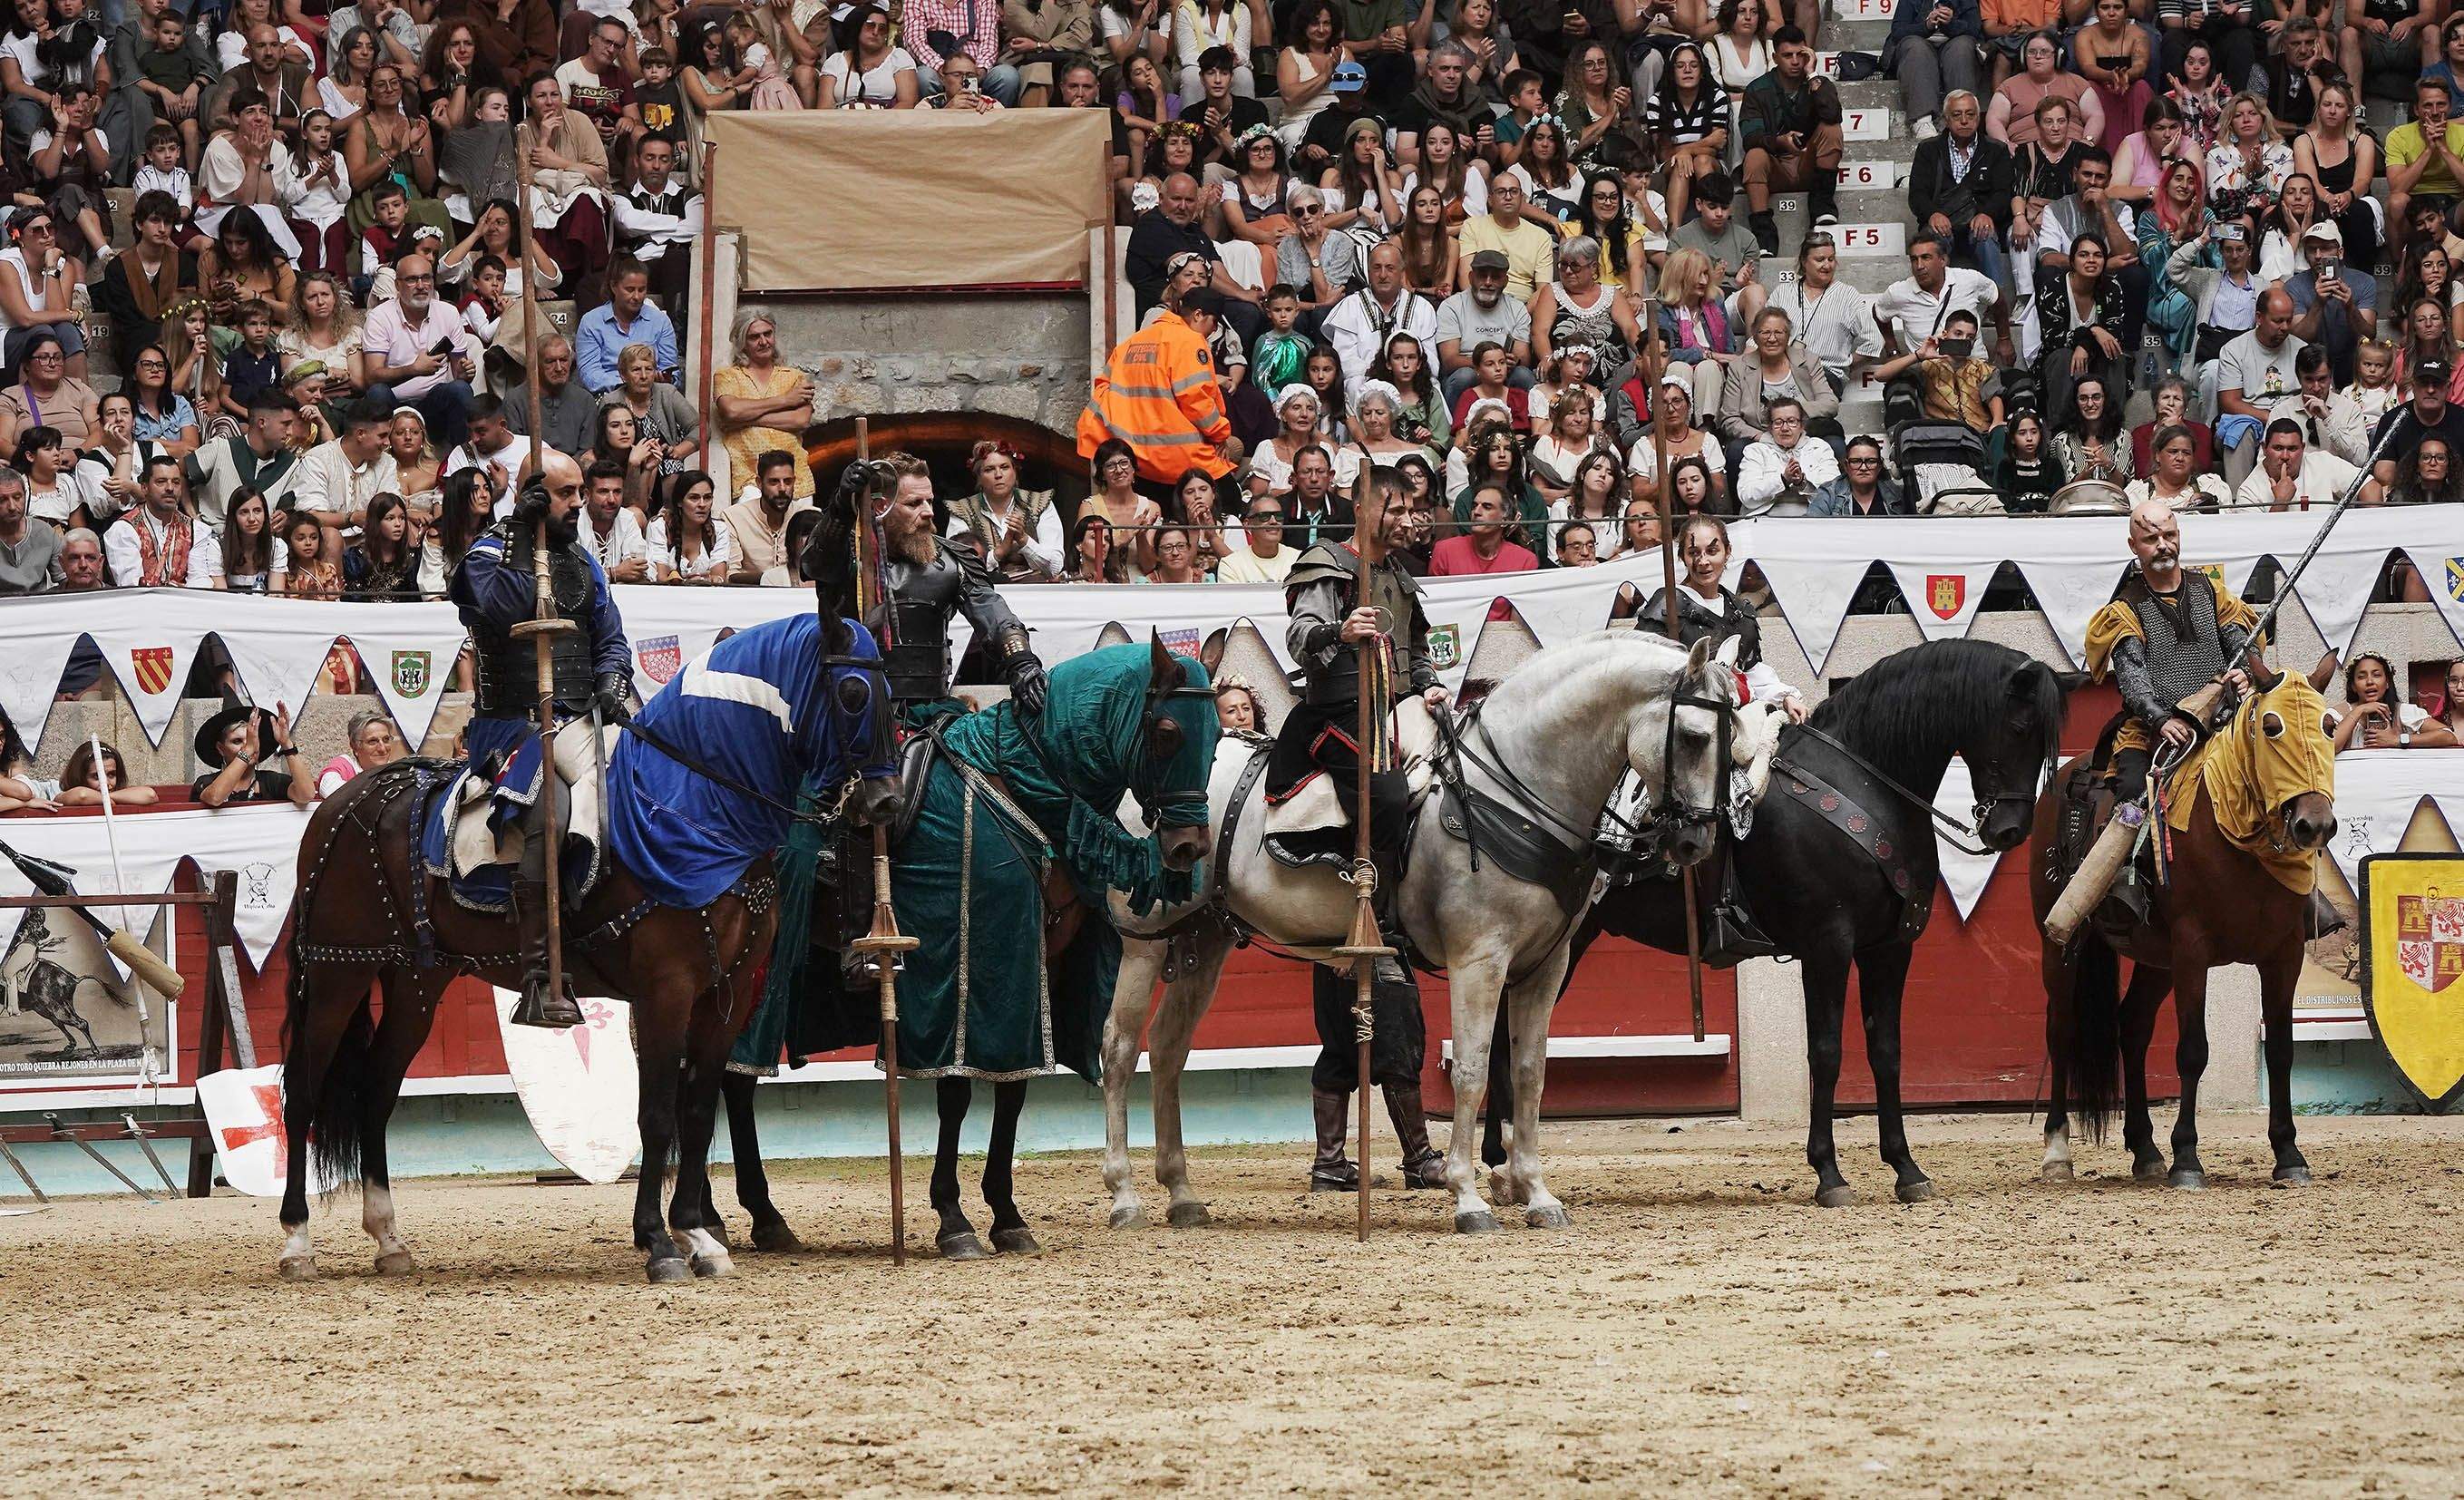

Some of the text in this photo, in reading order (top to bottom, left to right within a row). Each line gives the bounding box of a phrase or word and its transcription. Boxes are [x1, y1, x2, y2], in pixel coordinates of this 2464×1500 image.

[1850, 114, 1863, 130] 7
[1838, 167, 1872, 183] F 6
[1780, 200, 1796, 210] 39
[1846, 229, 1879, 246] F 5
[2375, 265, 2391, 275] 39
[1780, 272, 1795, 281] 33
[551, 314, 567, 324] 24
[93, 326, 108, 336] 19
[2145, 336, 2160, 346] 35
[0, 1063, 15, 1072] OTRO
[16, 1062, 33, 1072] TORO
[34, 1061, 61, 1073] QUIEBRA
[61, 1060, 89, 1070] REJONES
[89, 1060, 98, 1069] EN
[98, 1059, 106, 1068] LA
[107, 1058, 127, 1068] PLAZA
[128, 1058, 136, 1067] DE
